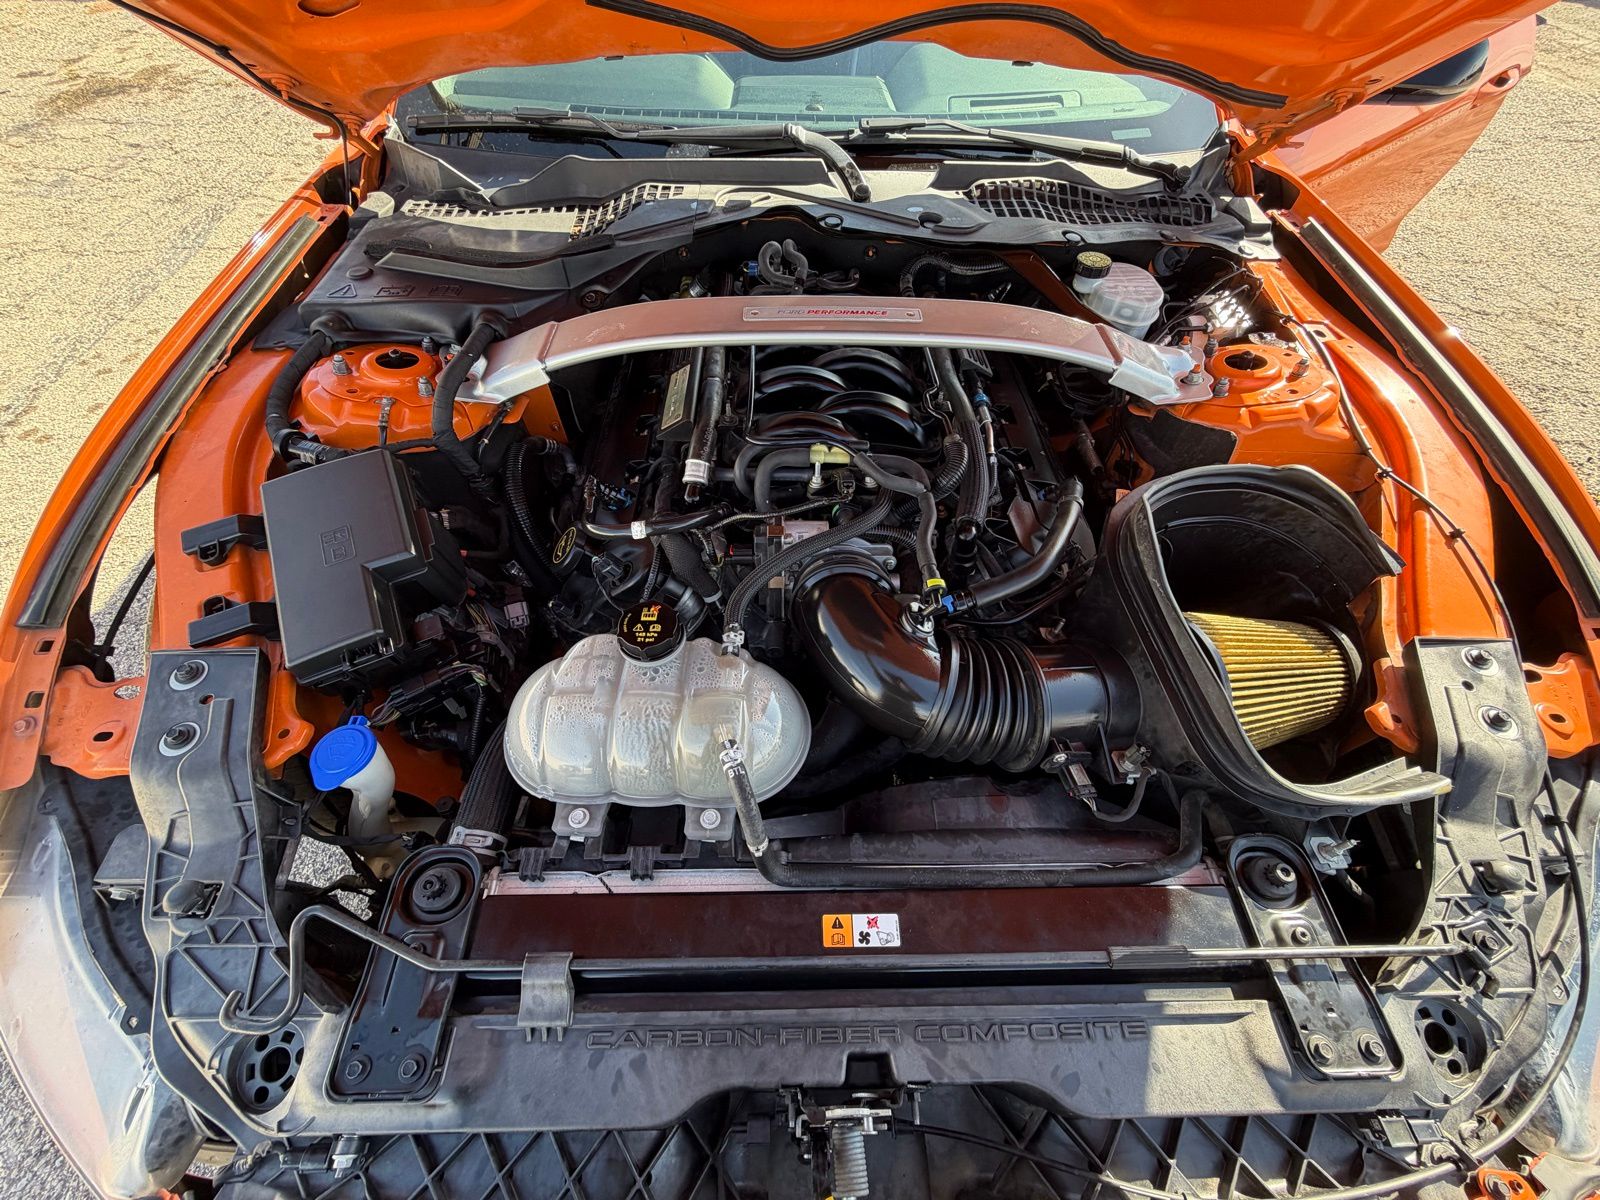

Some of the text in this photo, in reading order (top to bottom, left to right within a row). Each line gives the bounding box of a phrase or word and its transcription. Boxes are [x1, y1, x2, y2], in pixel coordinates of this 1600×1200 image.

[728, 766, 745, 778] BTL
[586, 1020, 1150, 1050] CARBON-FIBER COMPOSITE
